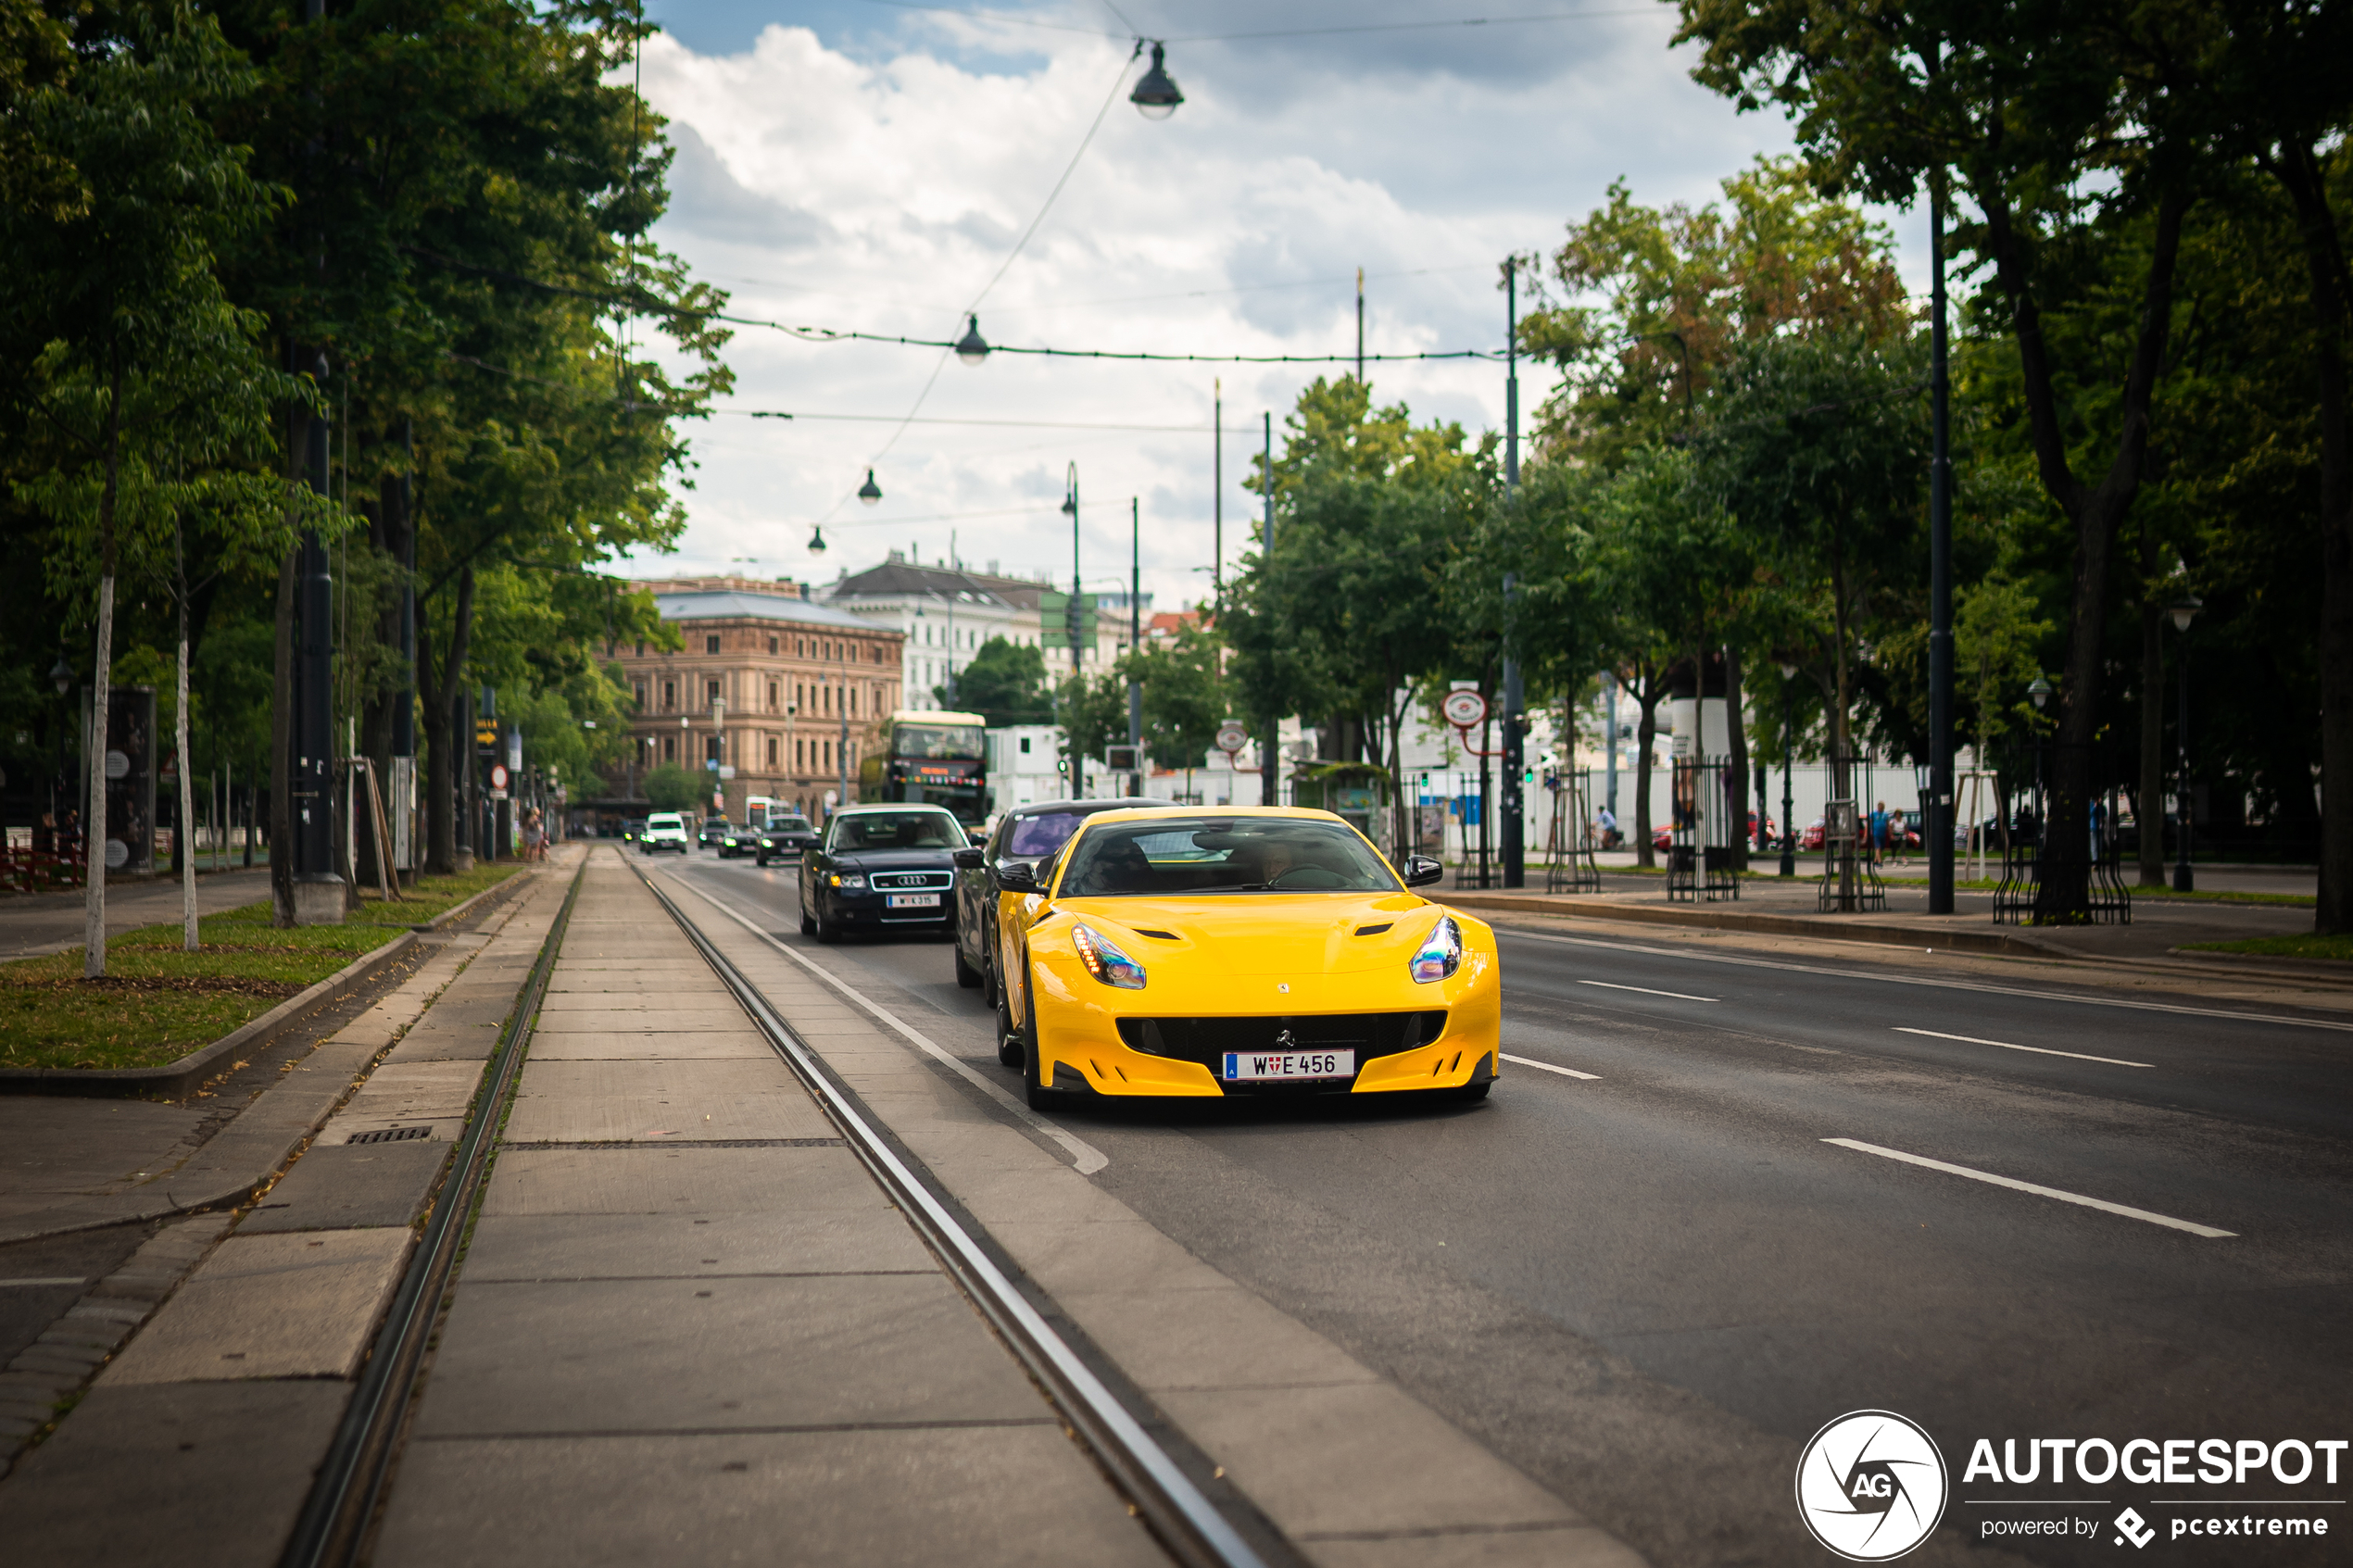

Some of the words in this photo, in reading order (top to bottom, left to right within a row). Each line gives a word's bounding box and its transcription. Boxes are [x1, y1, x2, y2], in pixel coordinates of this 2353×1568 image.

[1253, 1057, 1267, 1075] W
[1283, 1056, 1294, 1074] E
[1299, 1055, 1336, 1073] 456
